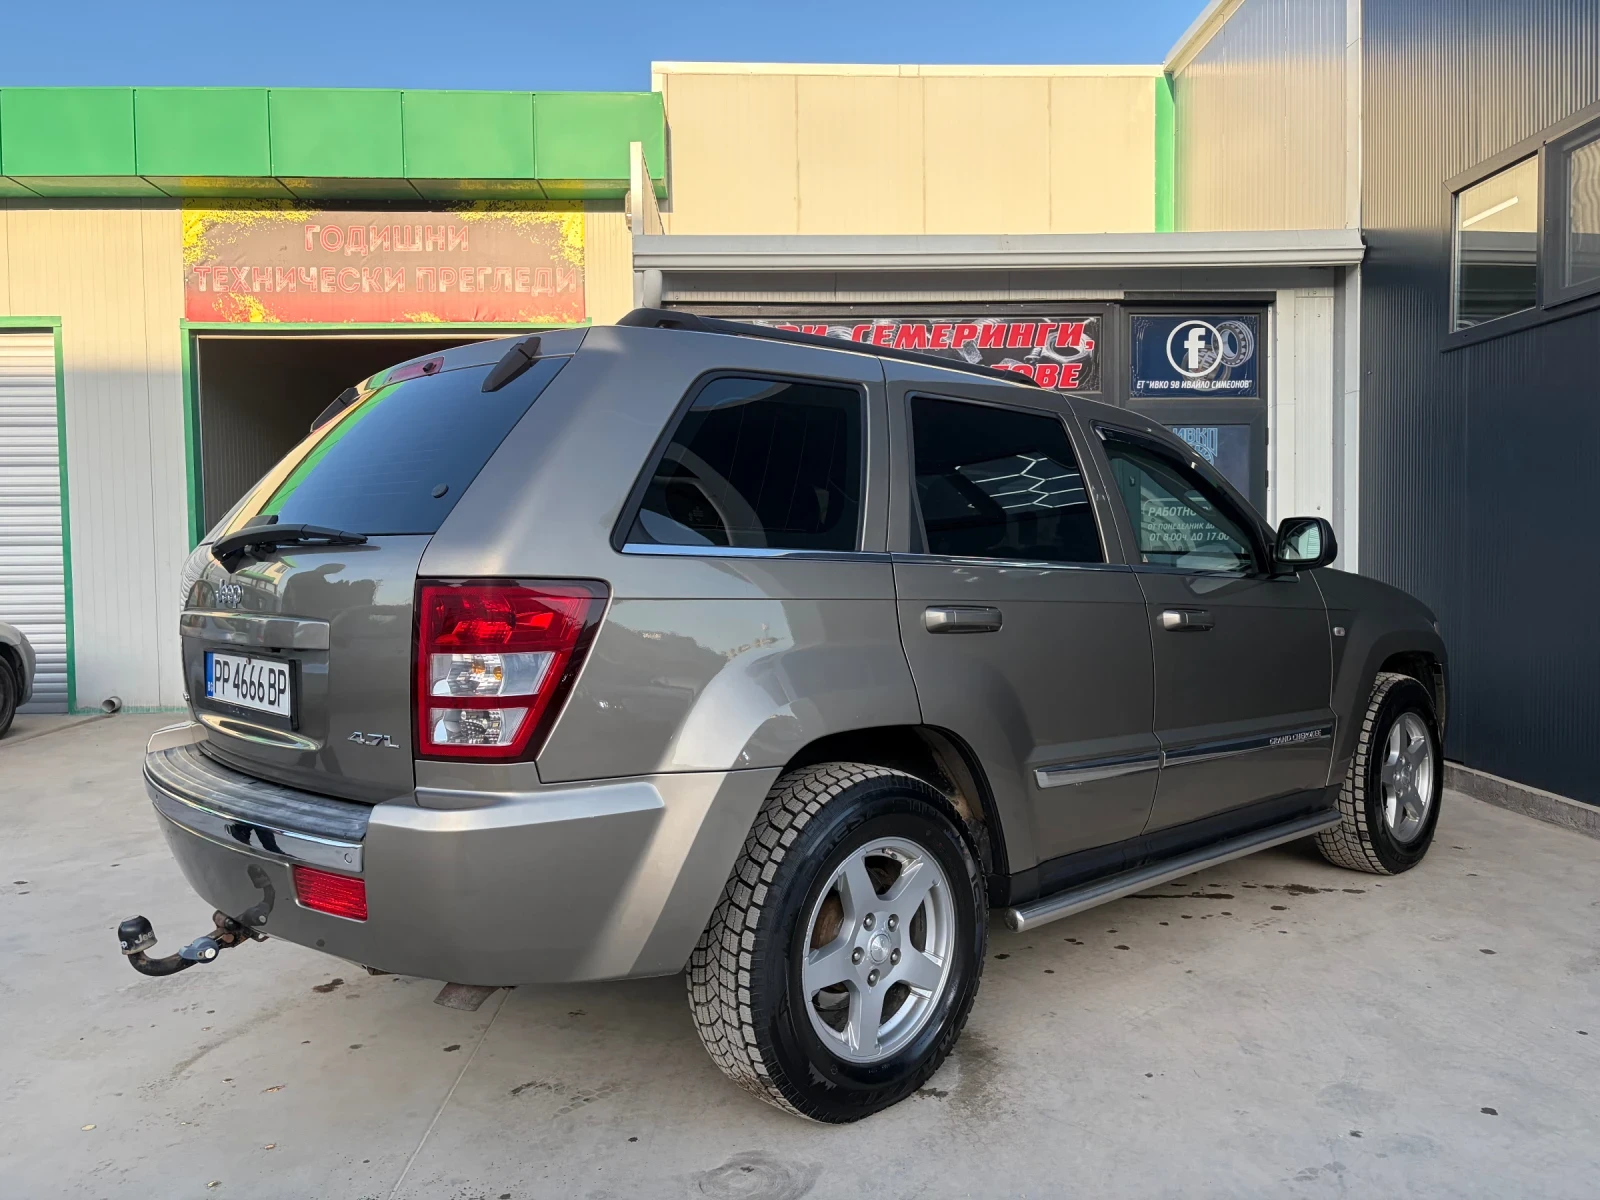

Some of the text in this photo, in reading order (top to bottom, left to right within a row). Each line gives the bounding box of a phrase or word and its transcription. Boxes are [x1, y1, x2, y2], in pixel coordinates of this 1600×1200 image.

[304, 224, 469, 256] ГОДИШНИ
[193, 266, 578, 297] ТЕХНИЧЕСКИ ПРЕГЛЕДИ
[1136, 380, 1146, 389] ЕТ
[1170, 380, 1180, 389] 98
[1181, 379, 1209, 389] ИВАЙЛО
[1149, 533, 1160, 541] ОТ
[1191, 532, 1203, 541] ДО
[214, 659, 287, 707] PP 4666 BP
